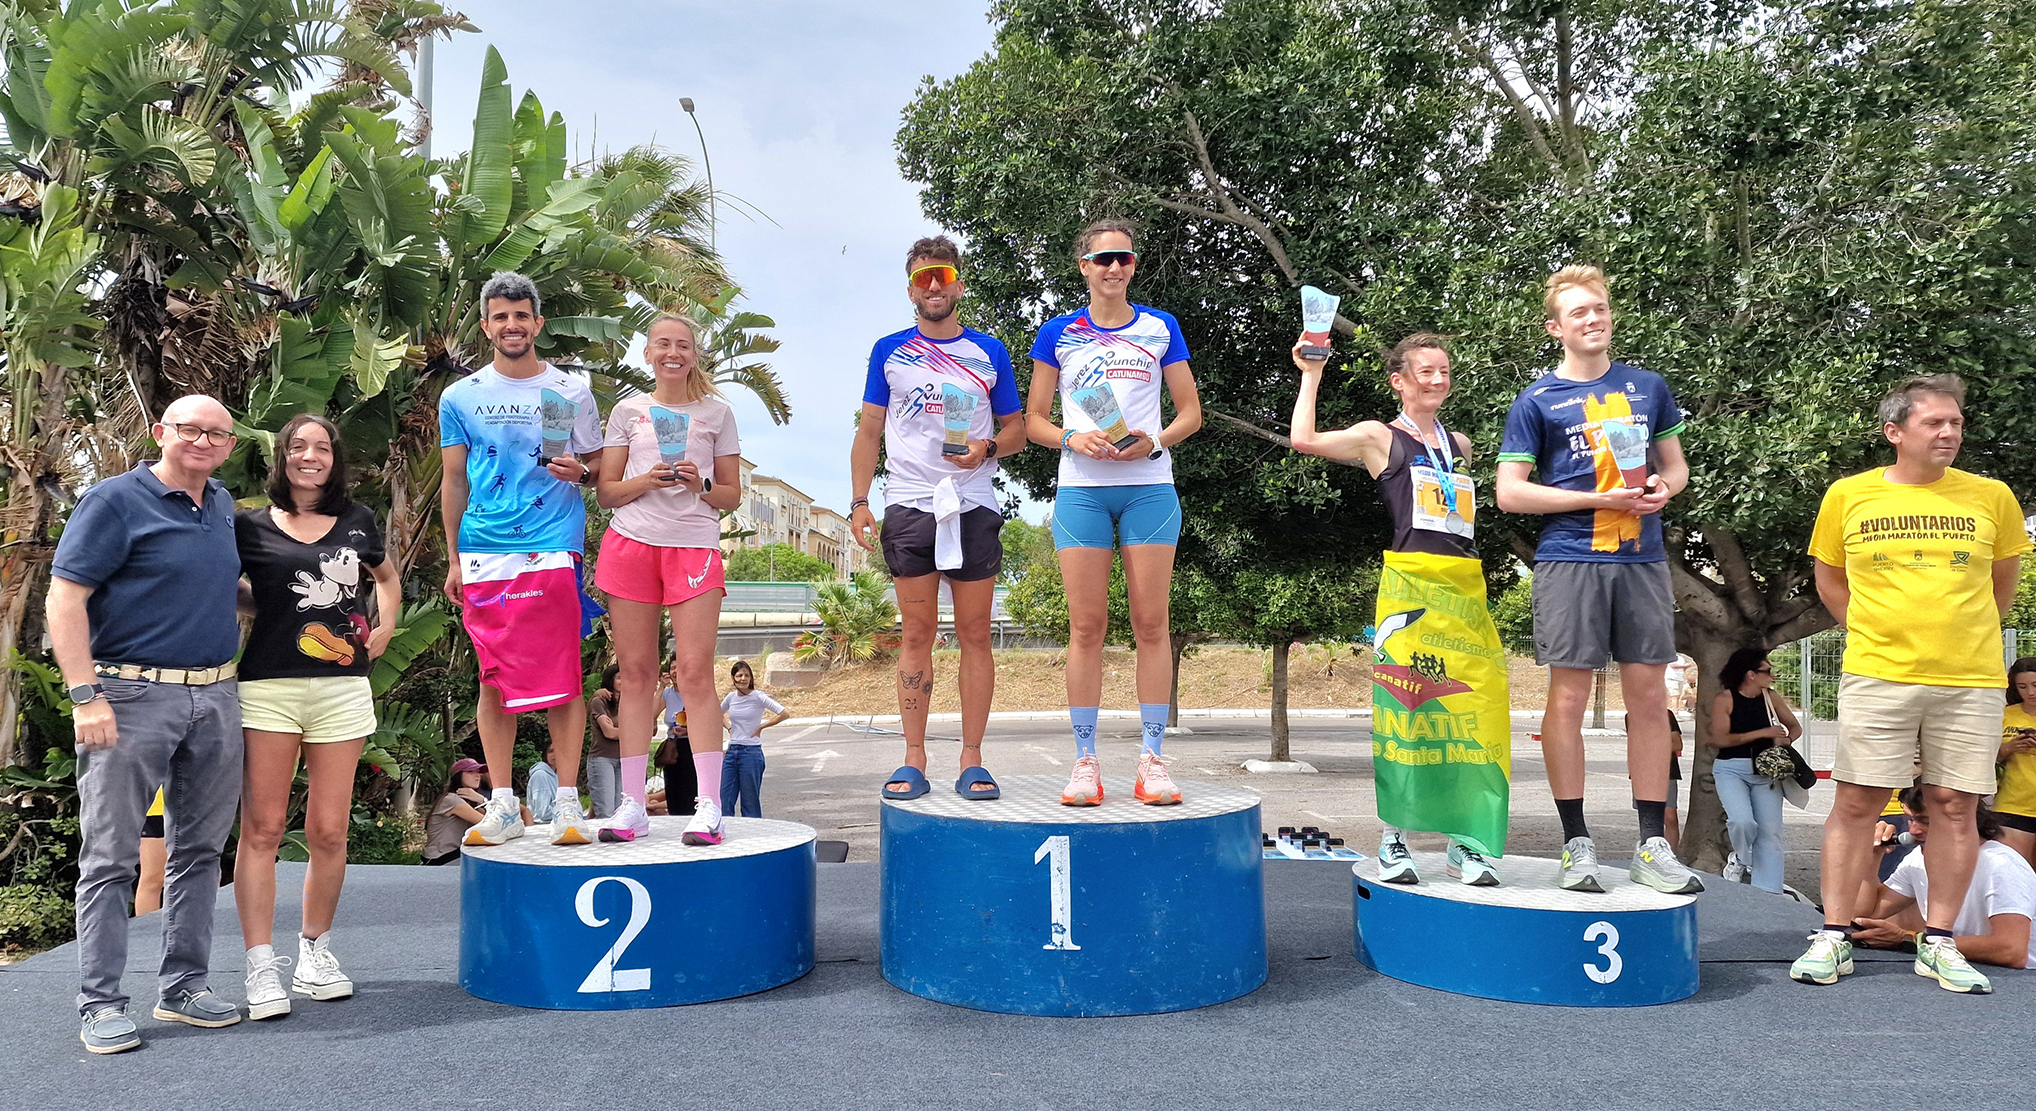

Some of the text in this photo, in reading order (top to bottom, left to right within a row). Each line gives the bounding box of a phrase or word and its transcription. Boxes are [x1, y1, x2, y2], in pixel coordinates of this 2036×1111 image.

[1565, 421, 1600, 435] MEDIA
[1569, 435, 1590, 451] EL
[1860, 515, 1976, 534] #VOLUNTARIOS
[1863, 534, 1886, 542] MEDIA
[1942, 532, 1976, 541] PUERTO
[505, 590, 544, 600] herakles
[1421, 632, 1491, 658] atletismo
[1373, 671, 1422, 694] canatif
[1384, 742, 1441, 763] Santa
[1034, 835, 1081, 950] 1
[575, 876, 652, 993] 2
[1583, 921, 1623, 984] 3
